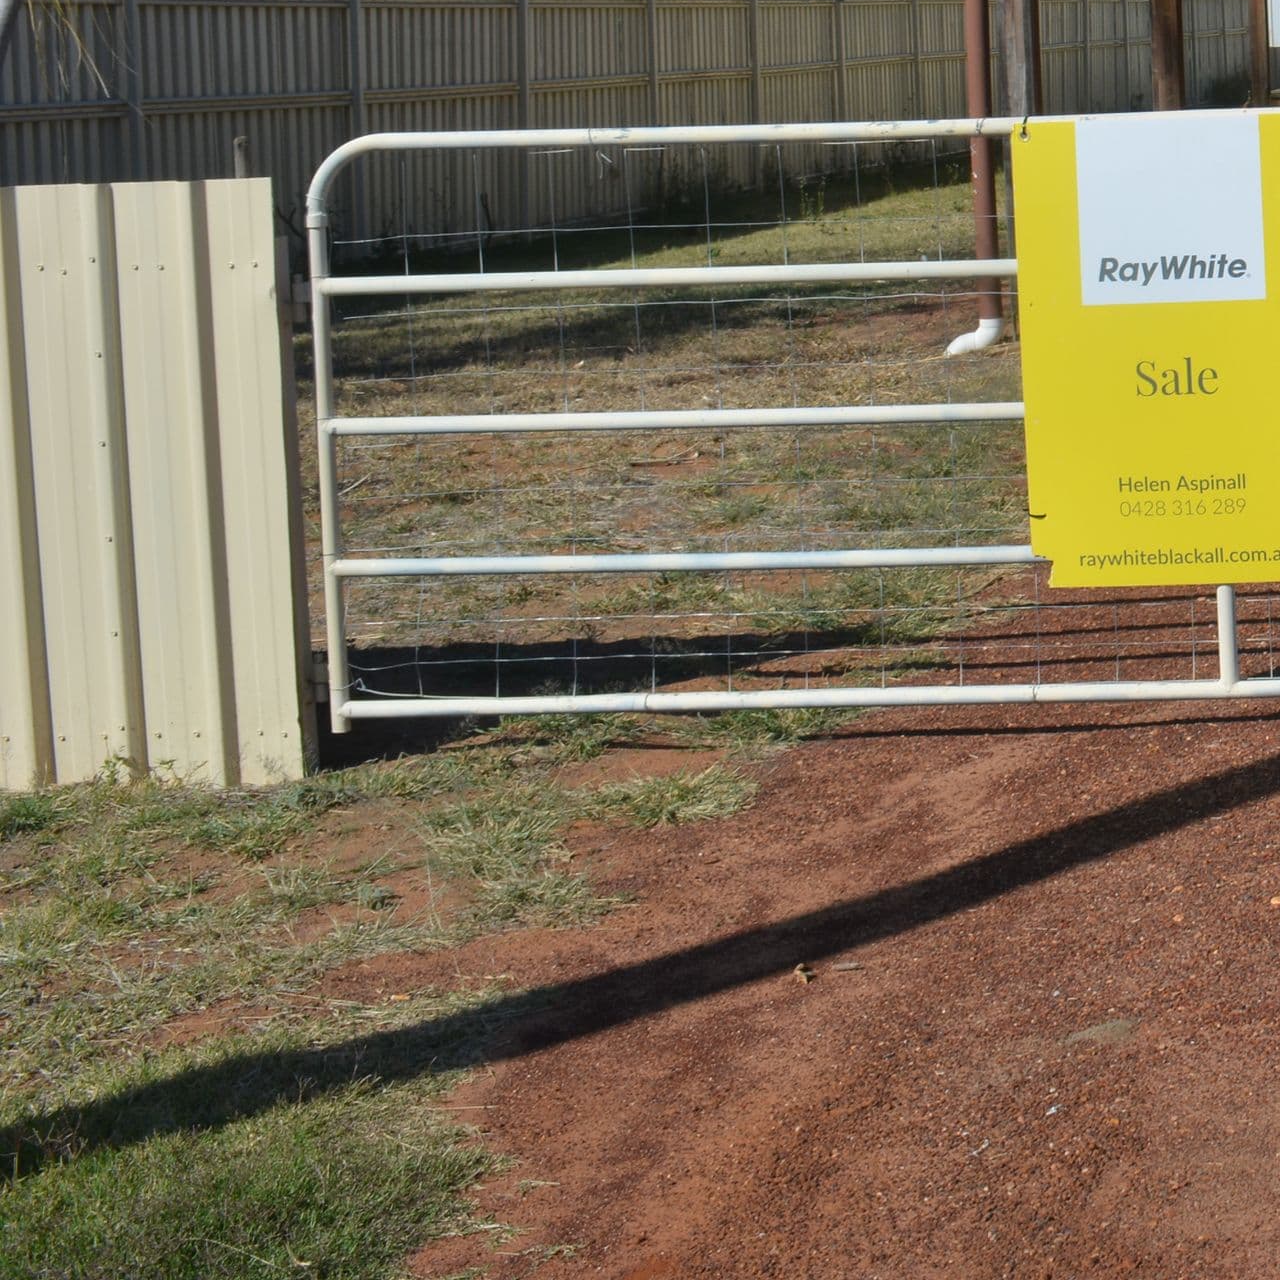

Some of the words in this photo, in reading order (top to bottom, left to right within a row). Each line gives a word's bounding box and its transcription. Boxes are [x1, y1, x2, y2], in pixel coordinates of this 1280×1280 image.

[1135, 357, 1219, 397] Sale
[1118, 475, 1171, 493] Helen
[1175, 472, 1247, 495] Aspinall
[1119, 500, 1167, 518] 0428
[1172, 499, 1207, 516] 316
[1212, 497, 1247, 515] 289
